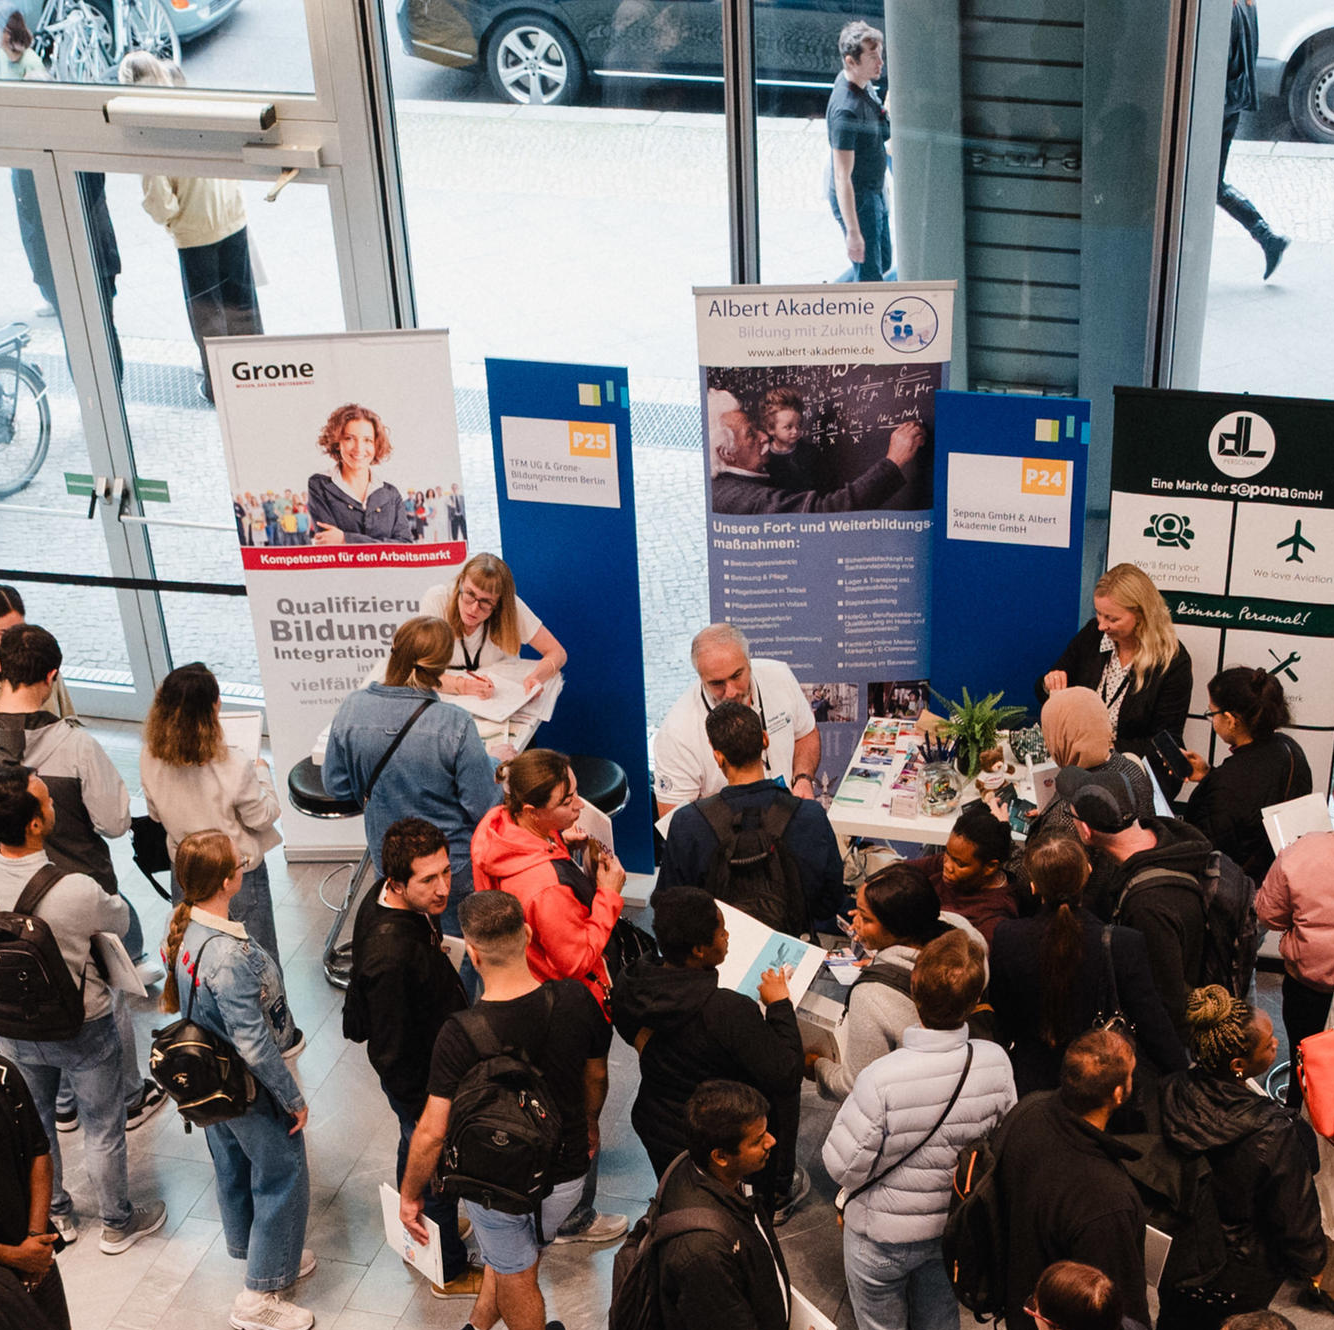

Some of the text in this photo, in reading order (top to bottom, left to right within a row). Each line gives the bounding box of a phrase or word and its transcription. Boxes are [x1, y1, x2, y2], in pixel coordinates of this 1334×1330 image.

[708, 298, 875, 317] Albert Akademie
[738, 323, 874, 341] Bildung mit Zukunft
[748, 345, 875, 358] www.albert-akademie.de
[232, 362, 314, 380] Grone
[573, 432, 606, 449] P25
[509, 459, 527, 468] TFM
[530, 461, 542, 469] UG
[554, 463, 581, 472] Grone-
[511, 471, 605, 485] Bildungszentren Berlin
[512, 482, 538, 491] GmbH
[1026, 469, 1062, 487] P24
[1151, 478, 1173, 490] Eine
[1176, 479, 1208, 492] Marke
[1211, 482, 1228, 494] der
[1290, 488, 1323, 500] GmbH
[953, 509, 1056, 525] Sepona GmbH & Albert
[713, 518, 934, 535] Unsere Fort- und Weiterbildungs-
[953, 521, 1027, 533] Akademie GmbH
[713, 537, 800, 550] maßnahmen:
[260, 550, 451, 566] Kompetenzen für den Arbeitsmarkt
[1170, 573, 1200, 584] match
[1253, 568, 1333, 585] We love Aviation
[277, 597, 420, 615] Qualifizieru
[1176, 601, 1311, 626] können Personal!
[273, 646, 385, 663] Integration
